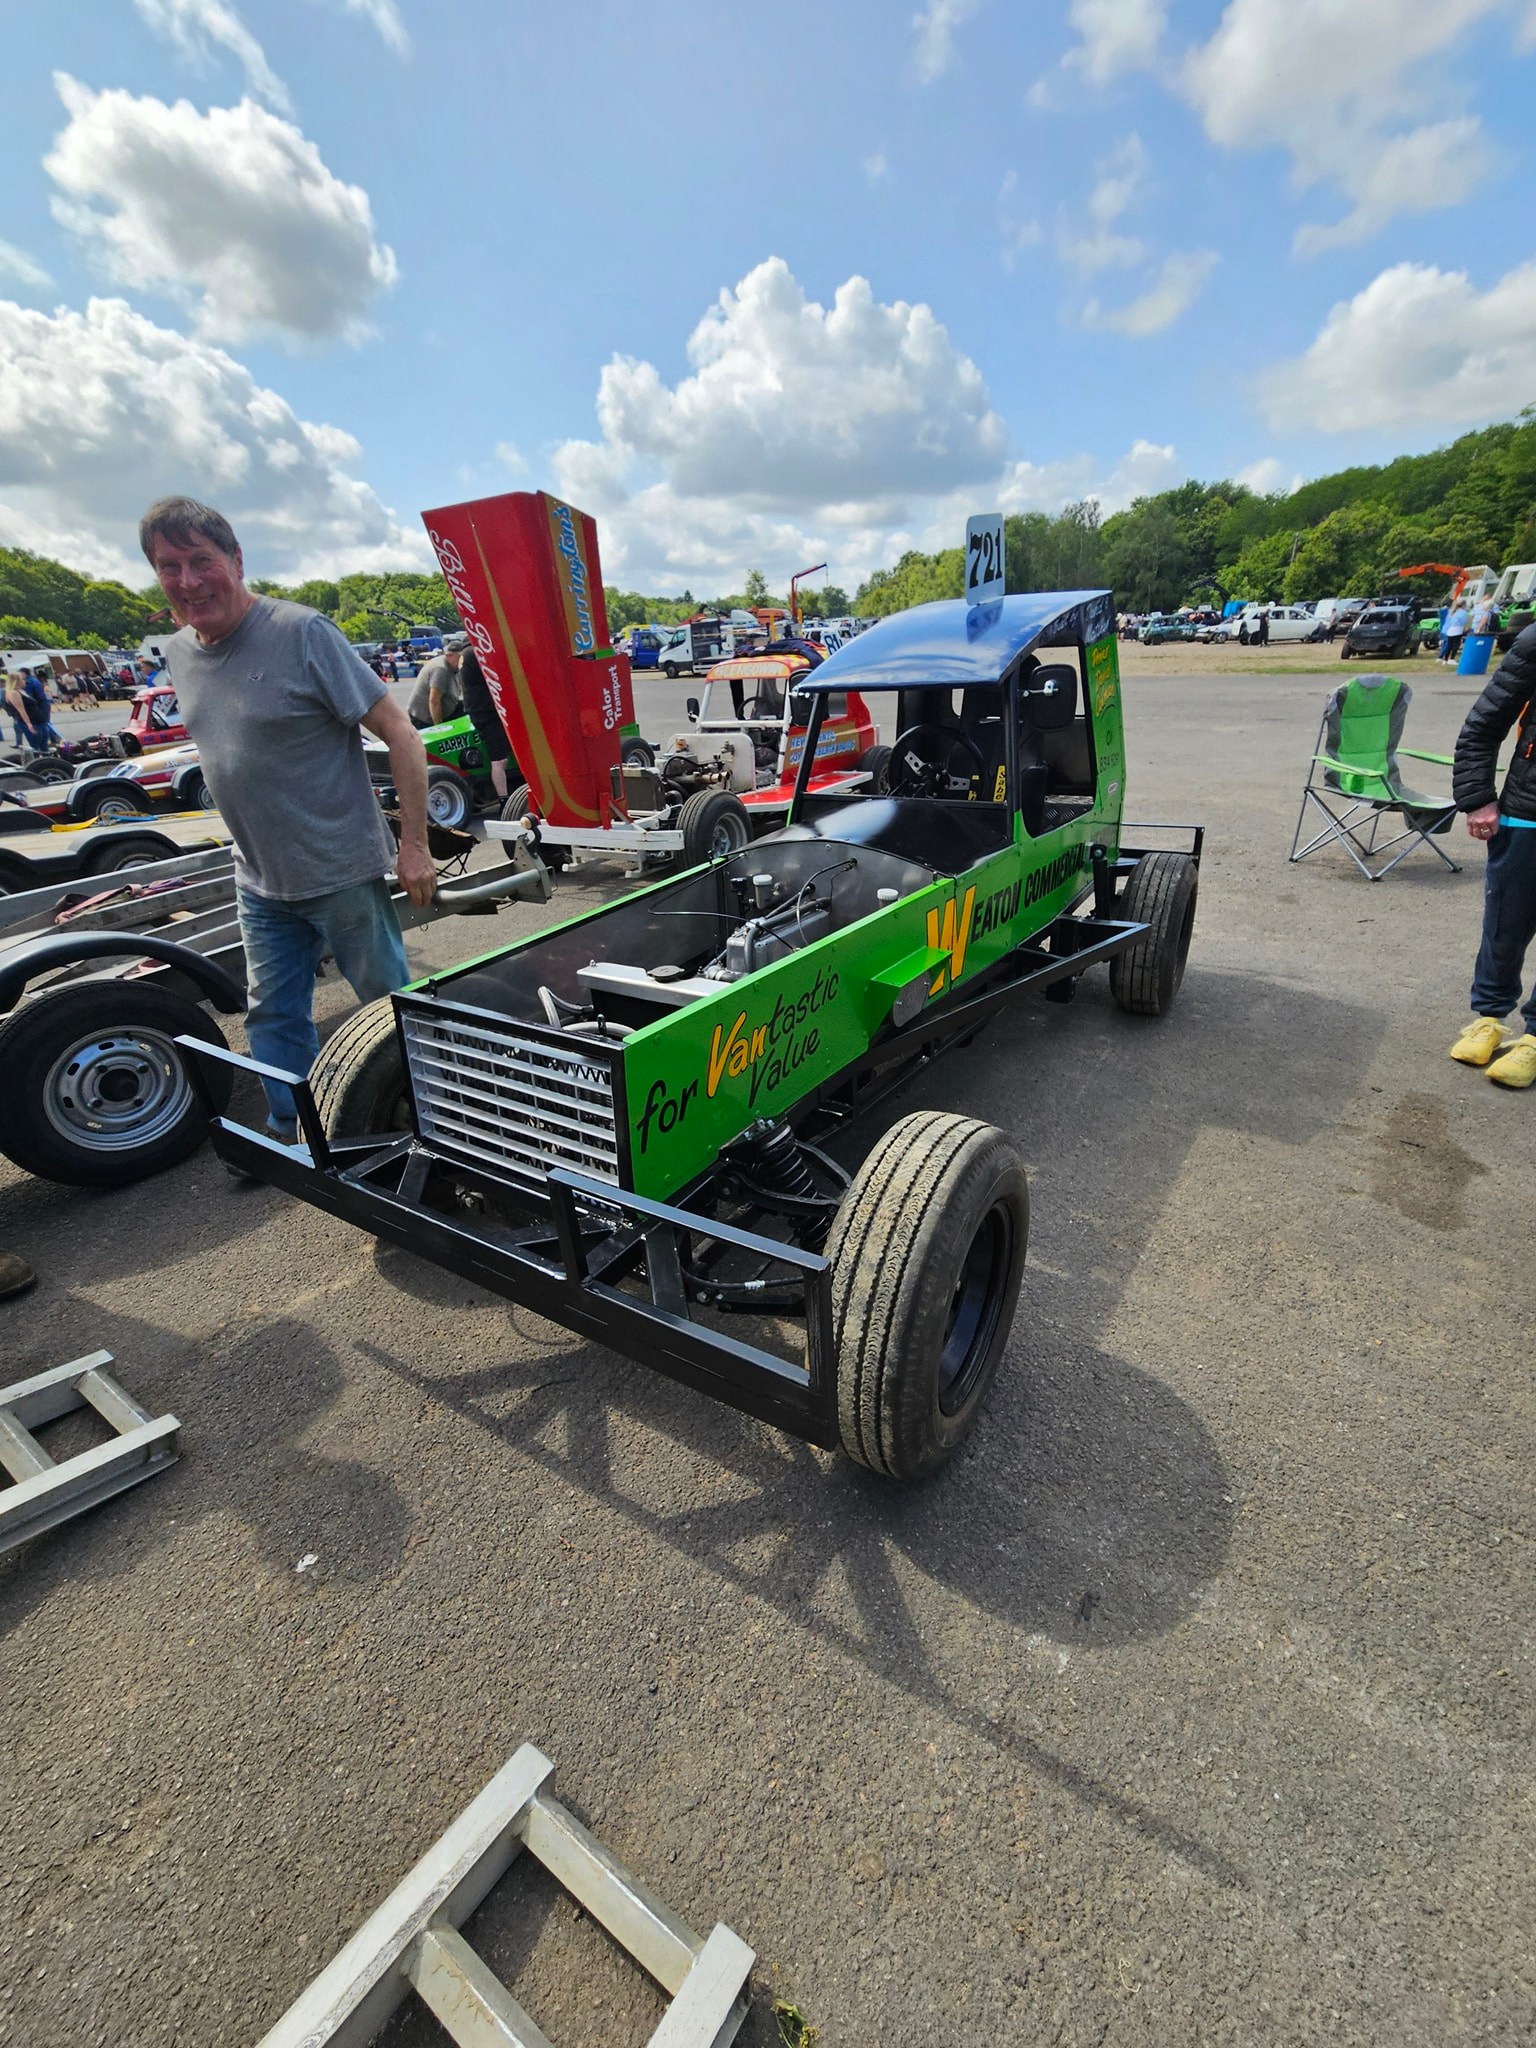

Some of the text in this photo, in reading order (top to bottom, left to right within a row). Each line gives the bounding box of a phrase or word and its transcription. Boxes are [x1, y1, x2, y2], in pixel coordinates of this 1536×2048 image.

[429, 529, 476, 613] Bill
[969, 527, 1003, 590] 721
[602, 687, 615, 730] Calor
[608, 664, 623, 722] Transport
[438, 734, 470, 755] BARRY
[926, 882, 1022, 998] WEATON
[636, 965, 839, 1155] for Vantastic
[748, 1027, 821, 1110] Value
